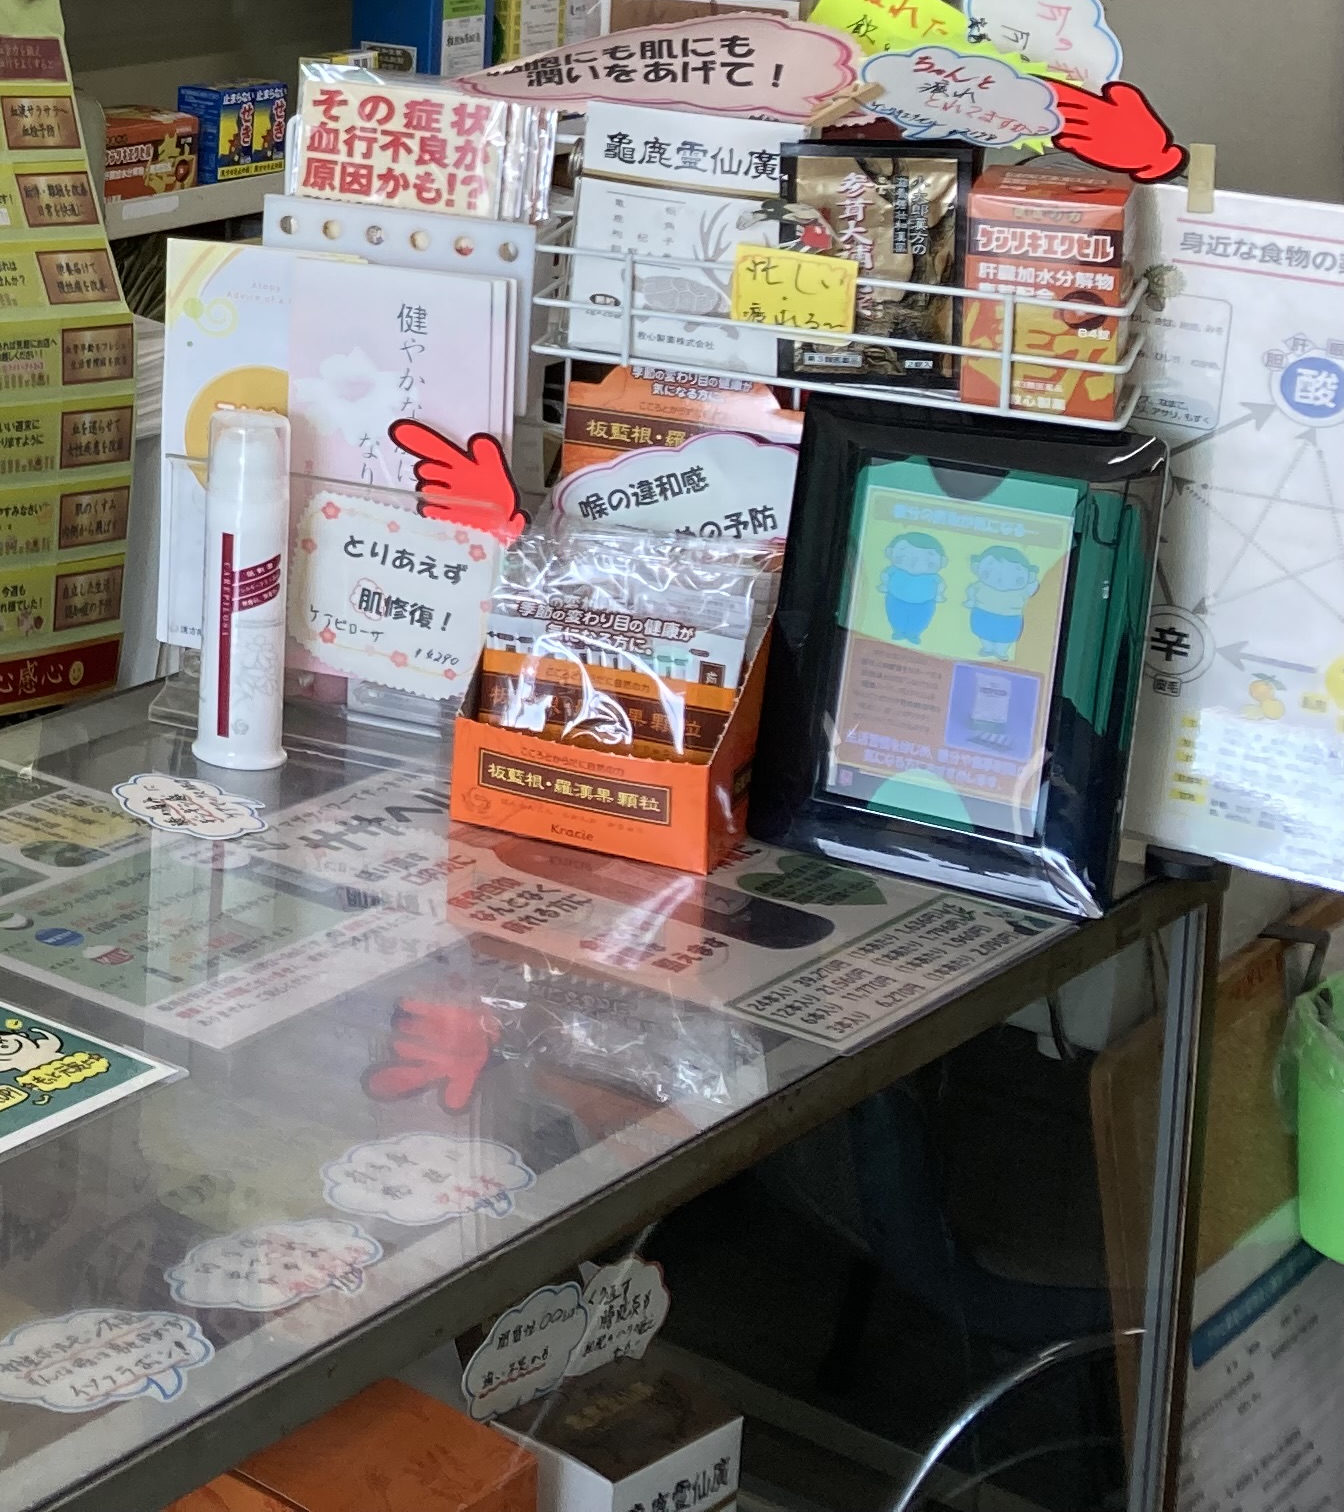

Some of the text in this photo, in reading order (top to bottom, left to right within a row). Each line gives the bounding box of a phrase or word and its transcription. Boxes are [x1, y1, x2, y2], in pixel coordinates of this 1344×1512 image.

[311, 89, 494, 136] その症状
[306, 128, 491, 172] 血行不良が
[1294, 369, 1339, 407] 酸
[578, 465, 709, 519] 喉の違和感
[344, 535, 468, 585] とりあえず
[1, 585, 26, 597] 今週も
[358, 587, 452, 631] 肌修復!
[520, 598, 694, 641] 季節の変わり目の健康が
[1150, 628, 1192, 661] 辛
[551, 825, 593, 842] Kracie
